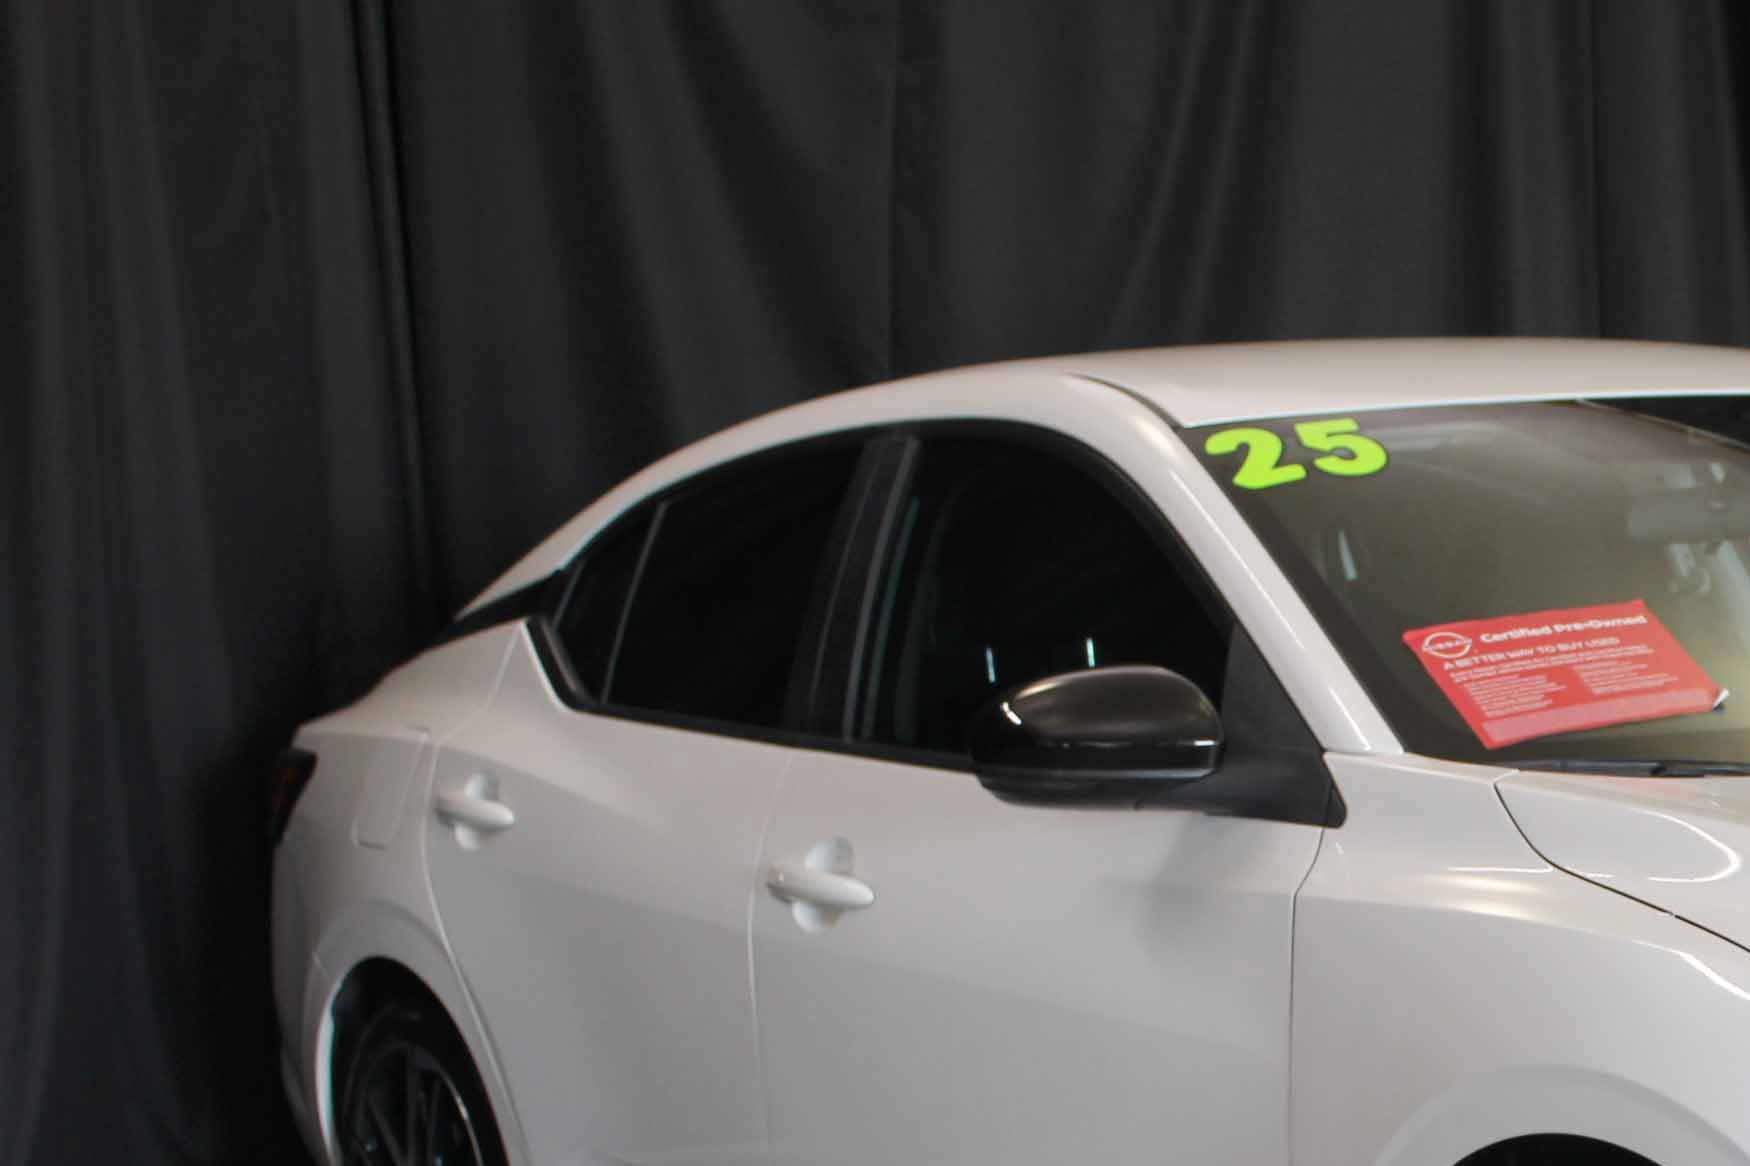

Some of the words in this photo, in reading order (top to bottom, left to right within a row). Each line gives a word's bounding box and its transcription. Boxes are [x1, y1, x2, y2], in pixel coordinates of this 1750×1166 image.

[1205, 418, 1388, 489] 25
[1480, 626, 1552, 643] Certified
[1552, 614, 1648, 633] Pre-Owned
